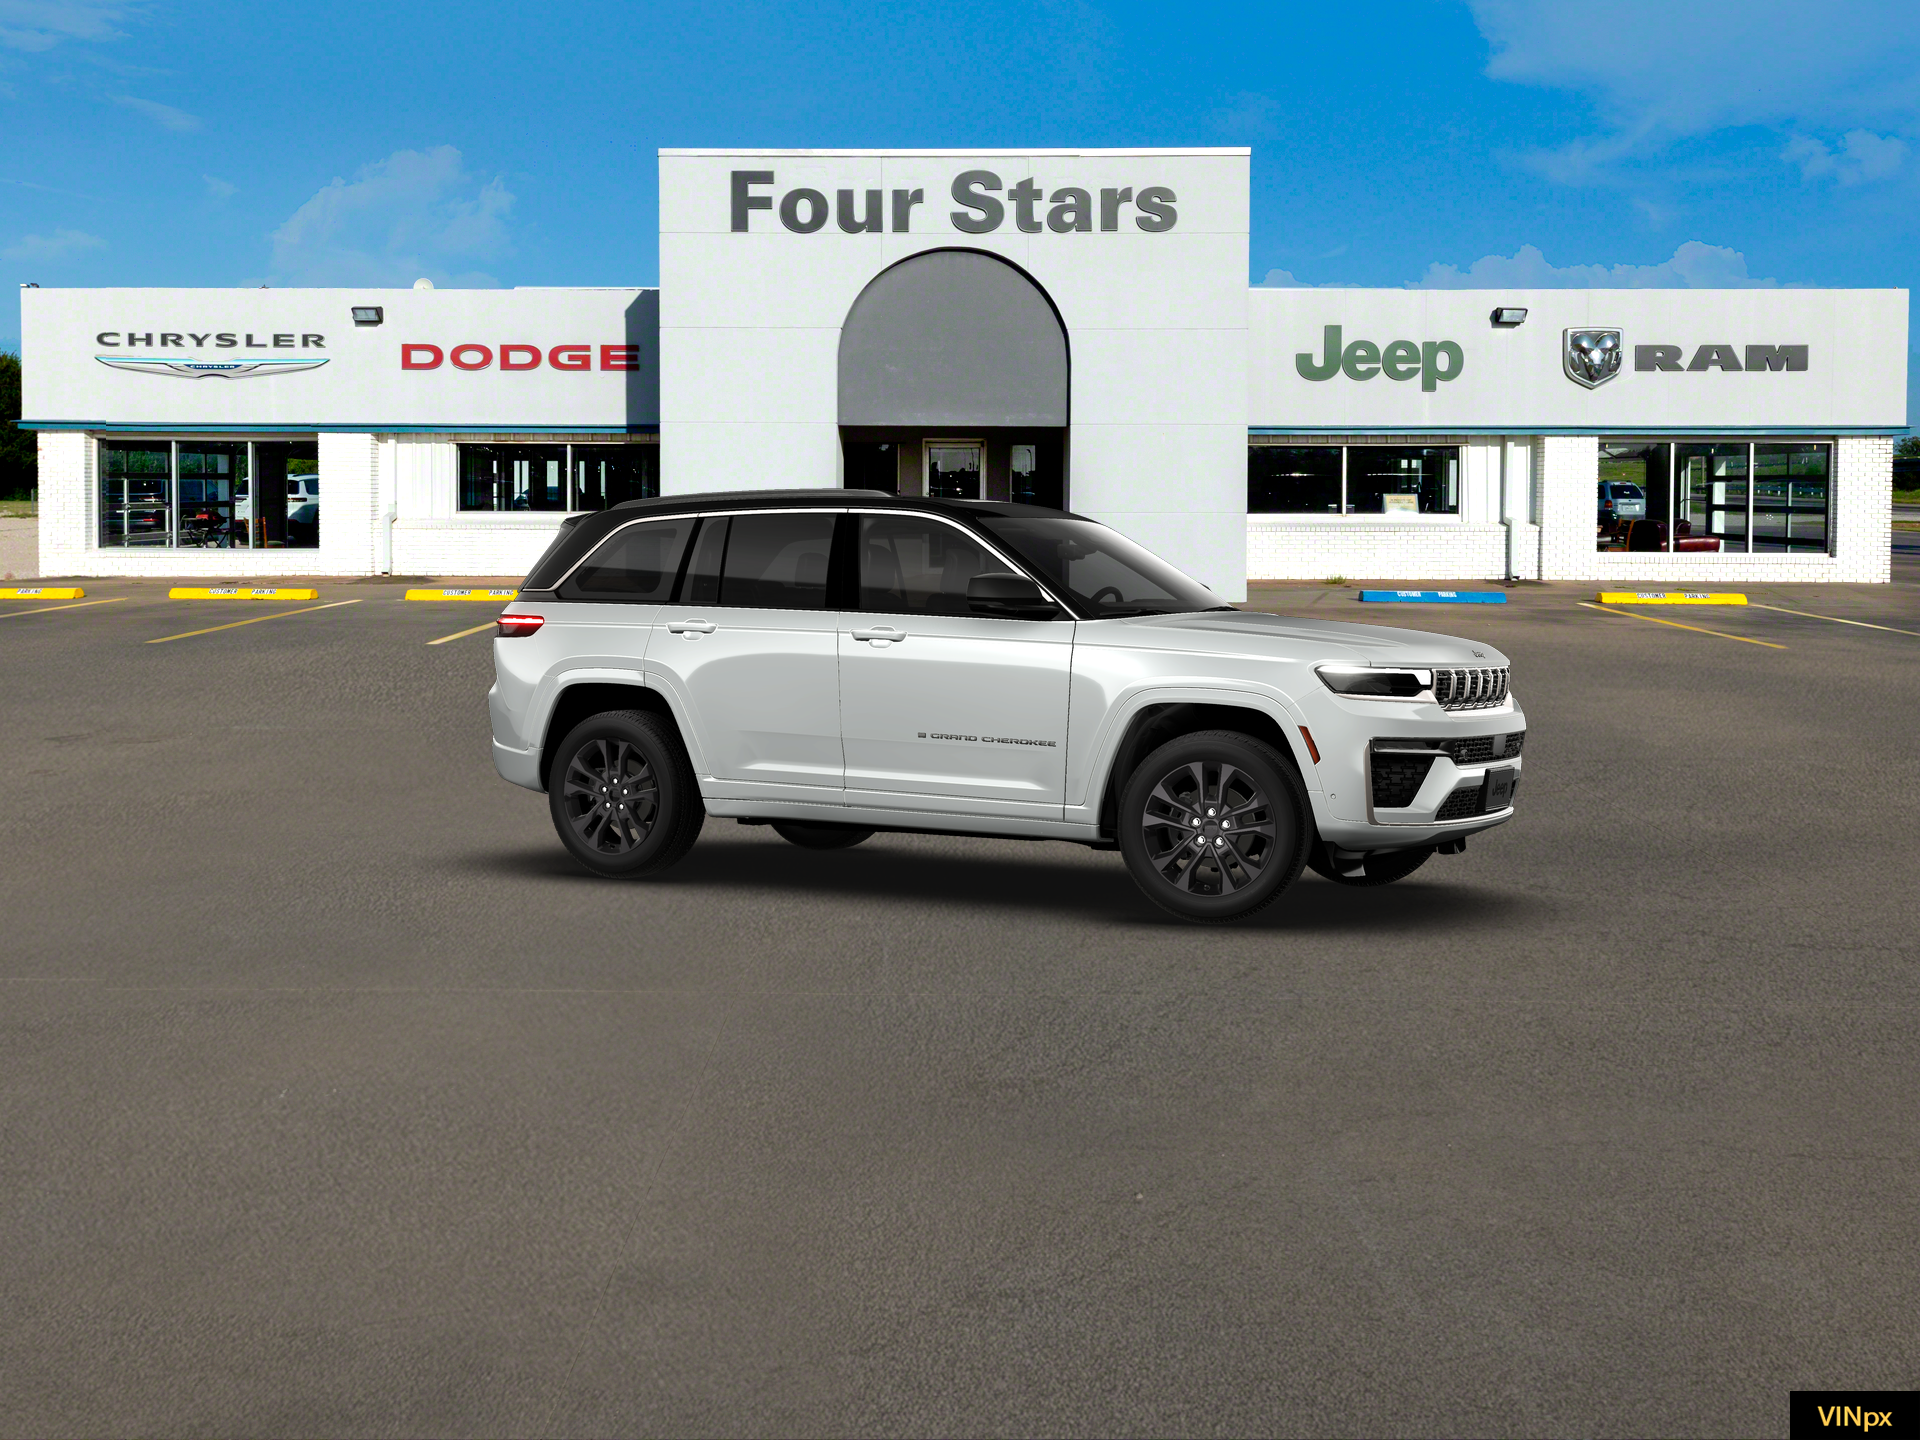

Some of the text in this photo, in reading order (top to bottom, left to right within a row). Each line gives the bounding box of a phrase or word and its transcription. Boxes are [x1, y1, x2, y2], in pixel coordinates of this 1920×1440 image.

[730, 169, 1178, 233] Four Stars
[96, 332, 326, 348] CHRYSLER
[401, 344, 640, 371] DODGE
[1296, 325, 1464, 392] Jeep
[1635, 344, 1809, 371] RAM
[930, 733, 1057, 747] GRAND CHEROKEE
